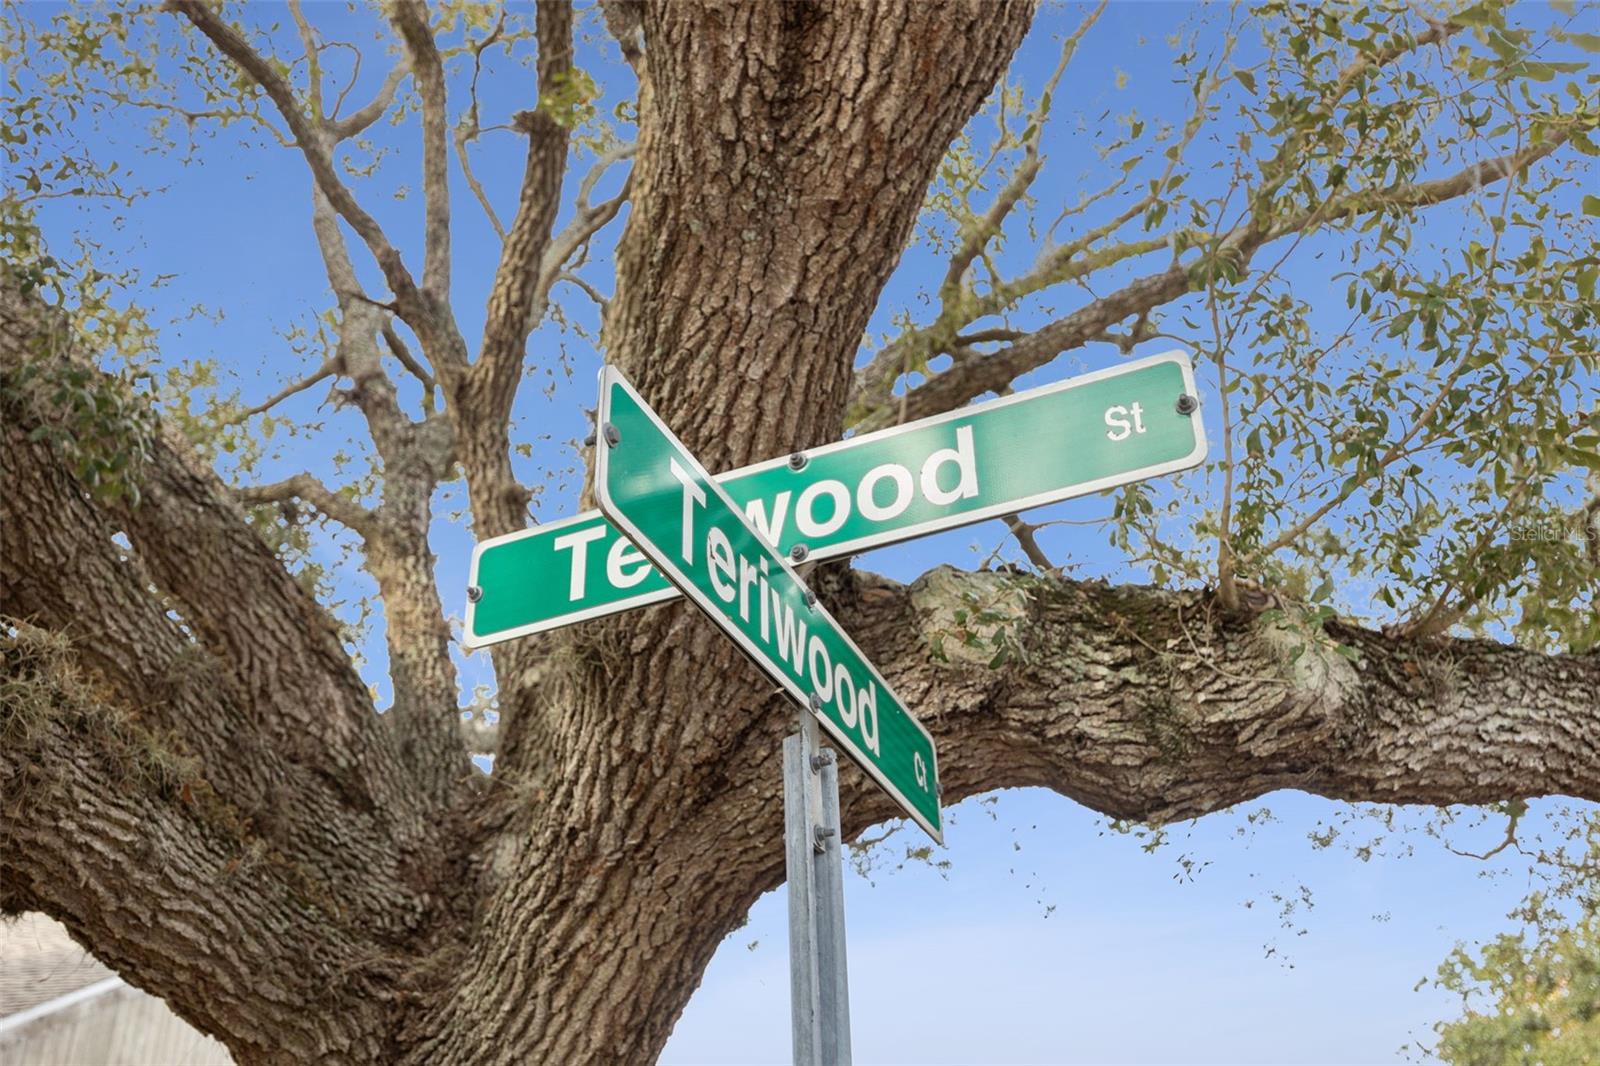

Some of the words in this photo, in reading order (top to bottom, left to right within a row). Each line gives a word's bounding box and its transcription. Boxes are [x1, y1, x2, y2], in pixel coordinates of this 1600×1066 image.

[553, 425, 979, 601] Tewood
[1104, 400, 1147, 442] St
[669, 456, 881, 758] Teriwood
[913, 750, 929, 793] Ct
